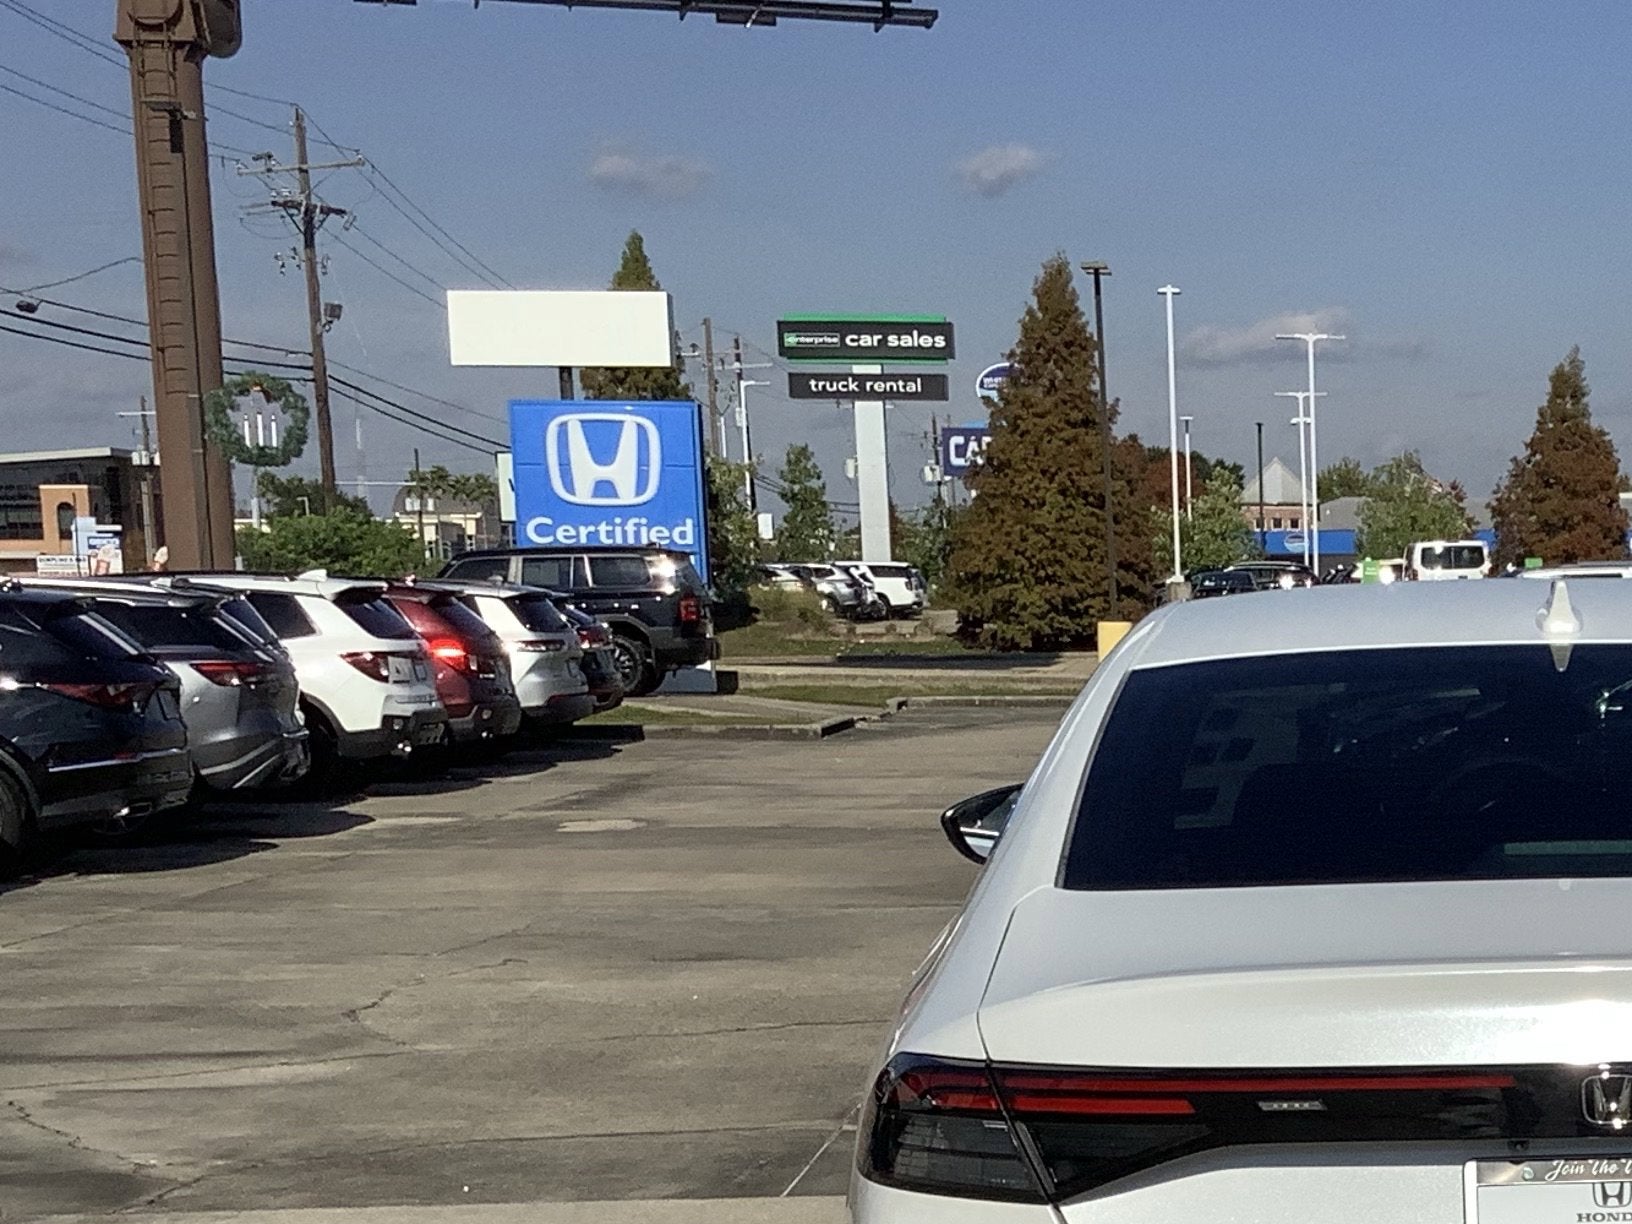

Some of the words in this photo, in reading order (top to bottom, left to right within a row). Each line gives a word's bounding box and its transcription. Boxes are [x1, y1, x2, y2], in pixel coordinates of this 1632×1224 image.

[786, 334, 839, 345] enterprise
[845, 334, 883, 347] car
[887, 330, 946, 347] sales
[809, 377, 860, 392] truck
[865, 378, 922, 392] rental
[526, 516, 694, 545] Certified
[1545, 1160, 1585, 1181] Join
